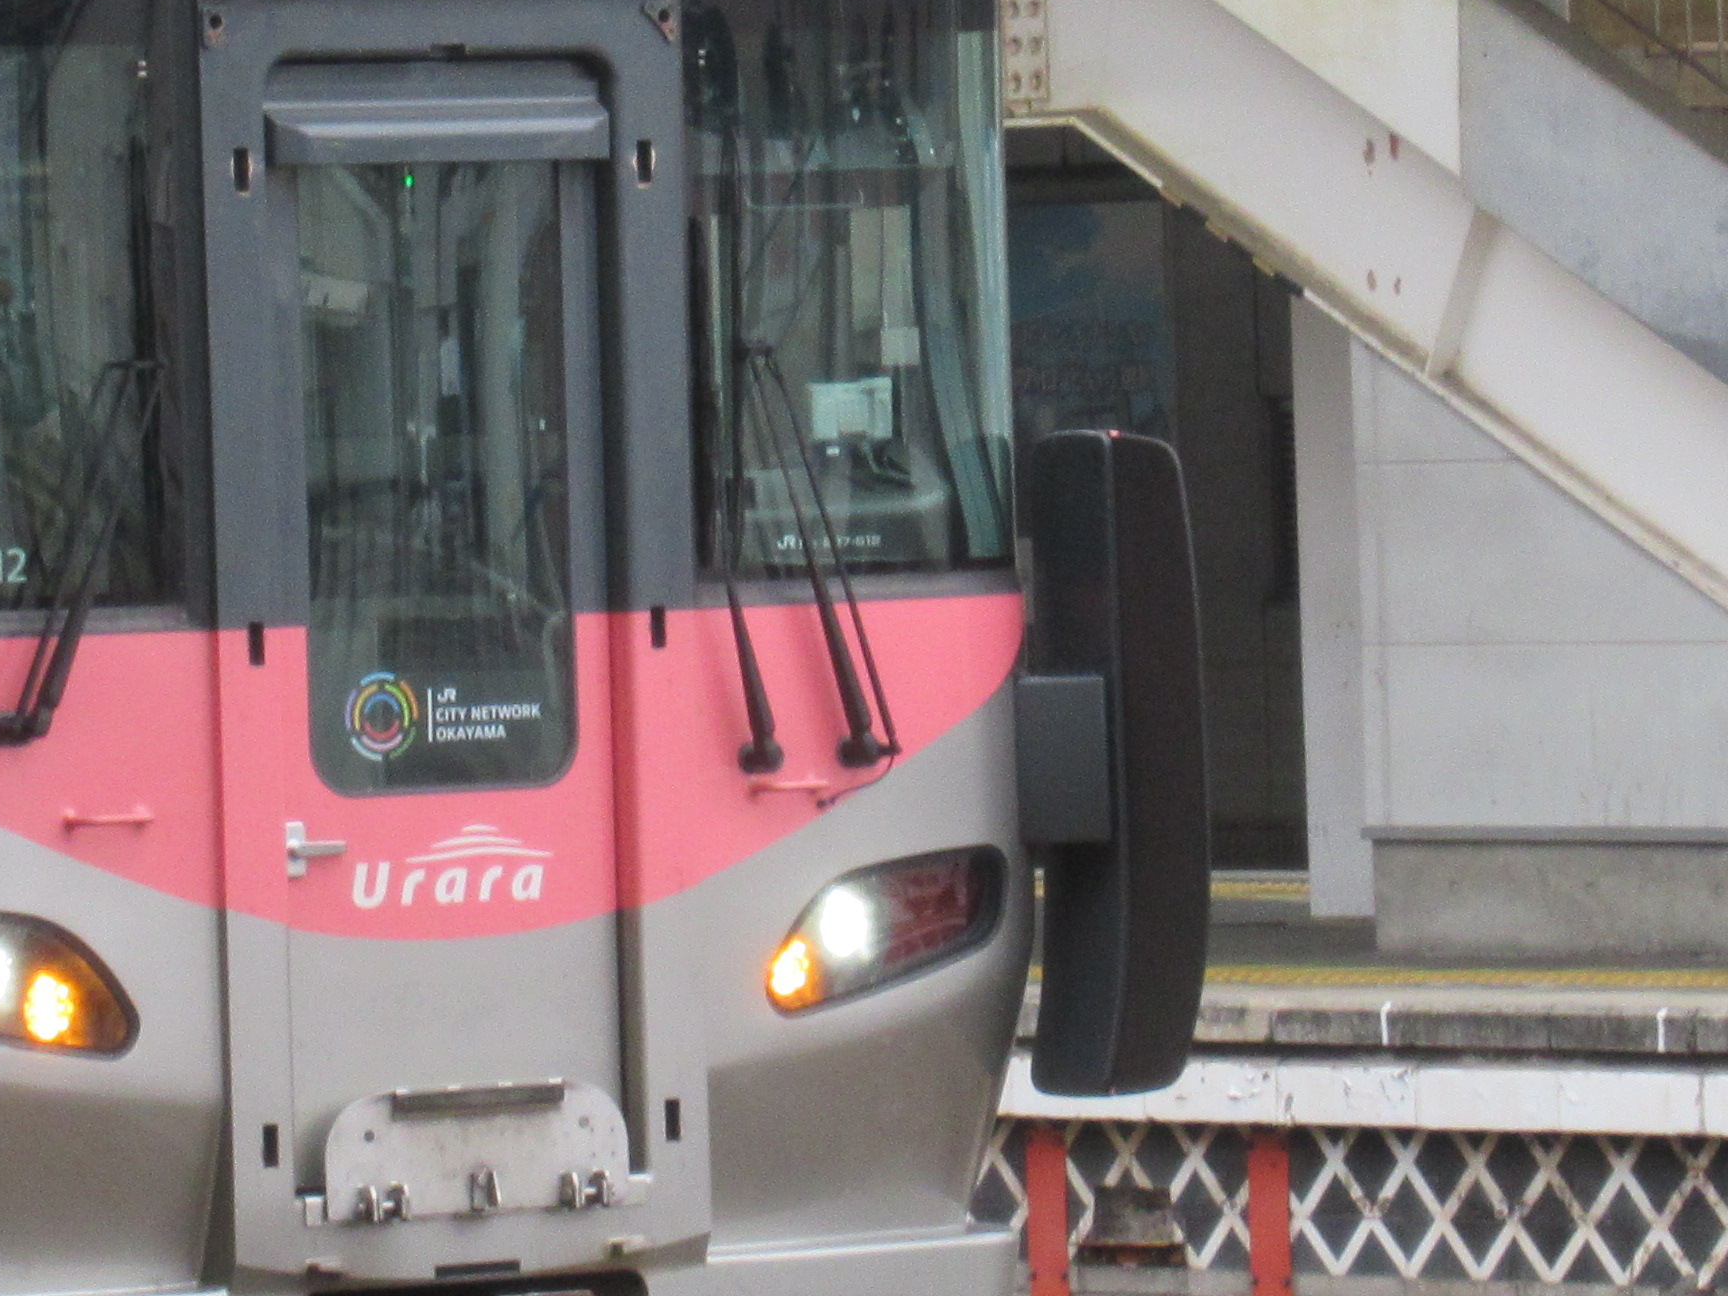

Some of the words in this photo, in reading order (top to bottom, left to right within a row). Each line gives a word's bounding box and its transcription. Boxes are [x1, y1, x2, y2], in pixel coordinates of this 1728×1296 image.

[436, 686, 457, 703] JR
[435, 706, 468, 723] CITY
[471, 704, 541, 721] NETWORK
[435, 724, 507, 741] OKAYAMA
[352, 861, 544, 910] Urara
